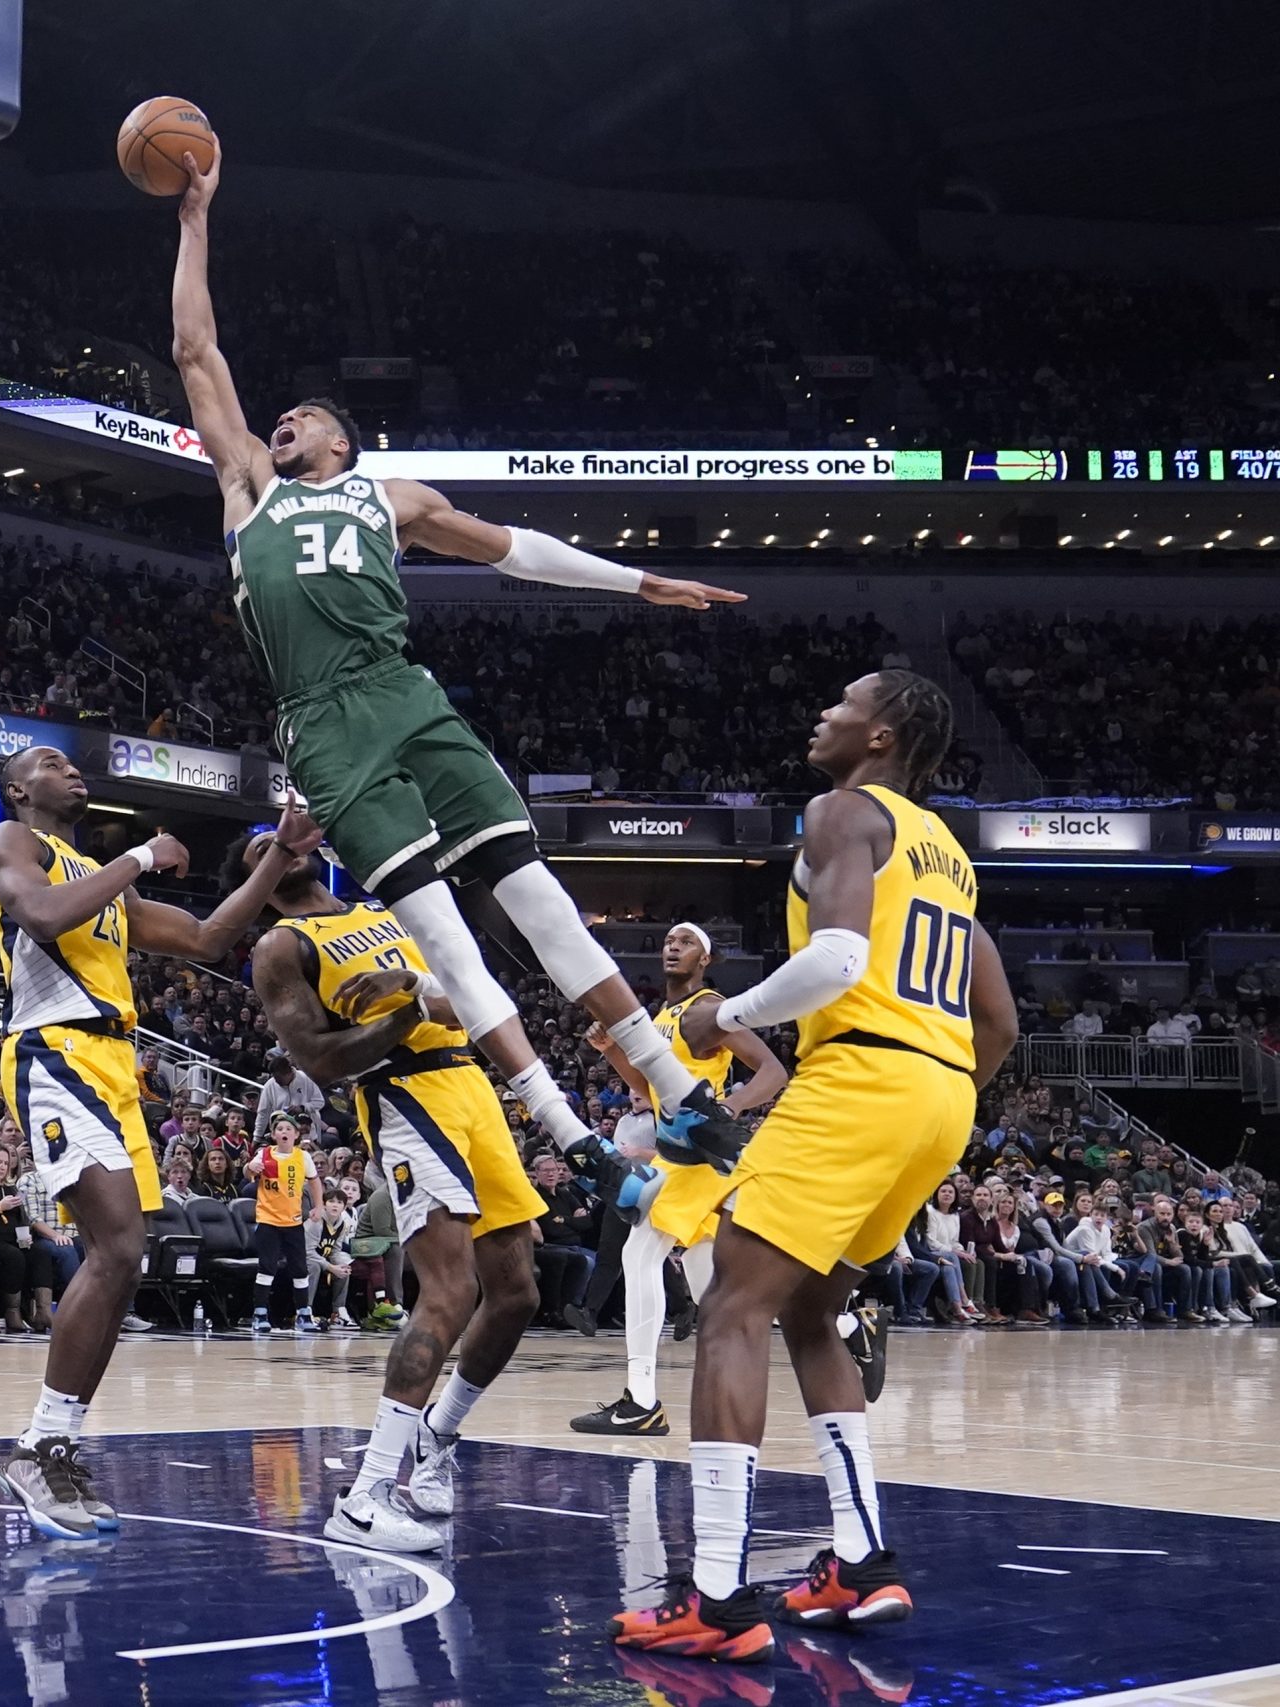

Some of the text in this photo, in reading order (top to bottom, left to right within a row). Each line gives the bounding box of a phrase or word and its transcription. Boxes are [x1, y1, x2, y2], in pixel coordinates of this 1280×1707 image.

[95, 411, 171, 449] KeyBank
[508, 453, 894, 480] Make financial progress one b
[1174, 450, 1198, 460] AST
[1231, 450, 1265, 460] FIELD
[1113, 461, 1139, 479] 26
[1175, 461, 1199, 479] 19
[266, 493, 388, 532] MILWAUKEE
[294, 523, 364, 575] 34
[110, 737, 239, 792] aes Indiana
[609, 817, 683, 835] verizon
[1048, 815, 1111, 835] slack
[1226, 827, 1242, 841] WE
[1243, 827, 1272, 841] GROW
[906, 841, 974, 901] MATHURIN
[896, 897, 973, 1018] 00
[264, 1180, 279, 1193] 34
[287, 1165, 296, 1198] BUCKS
